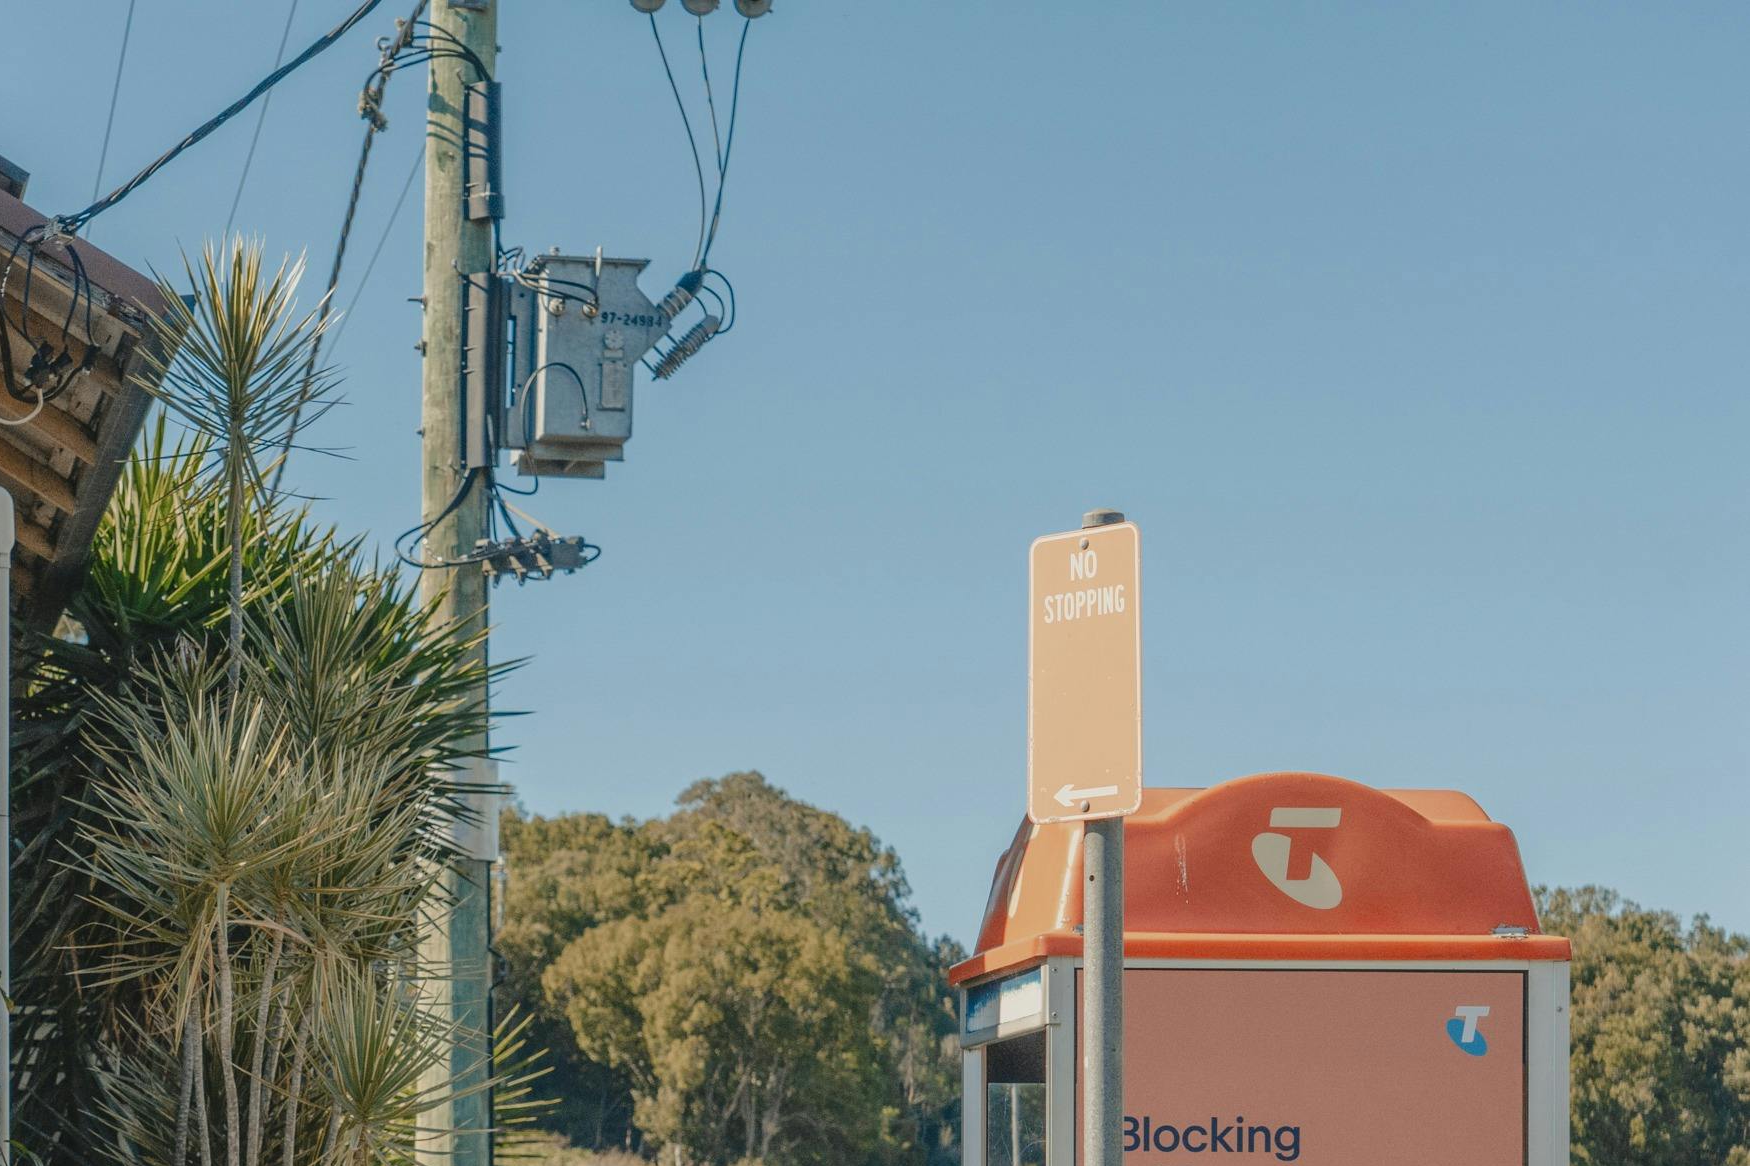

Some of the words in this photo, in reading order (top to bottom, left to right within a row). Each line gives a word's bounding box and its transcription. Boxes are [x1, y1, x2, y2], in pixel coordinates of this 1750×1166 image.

[1069, 550, 1097, 581] NO
[1044, 584, 1125, 623] STOPPING
[1123, 1116, 1300, 1161] Blocking
